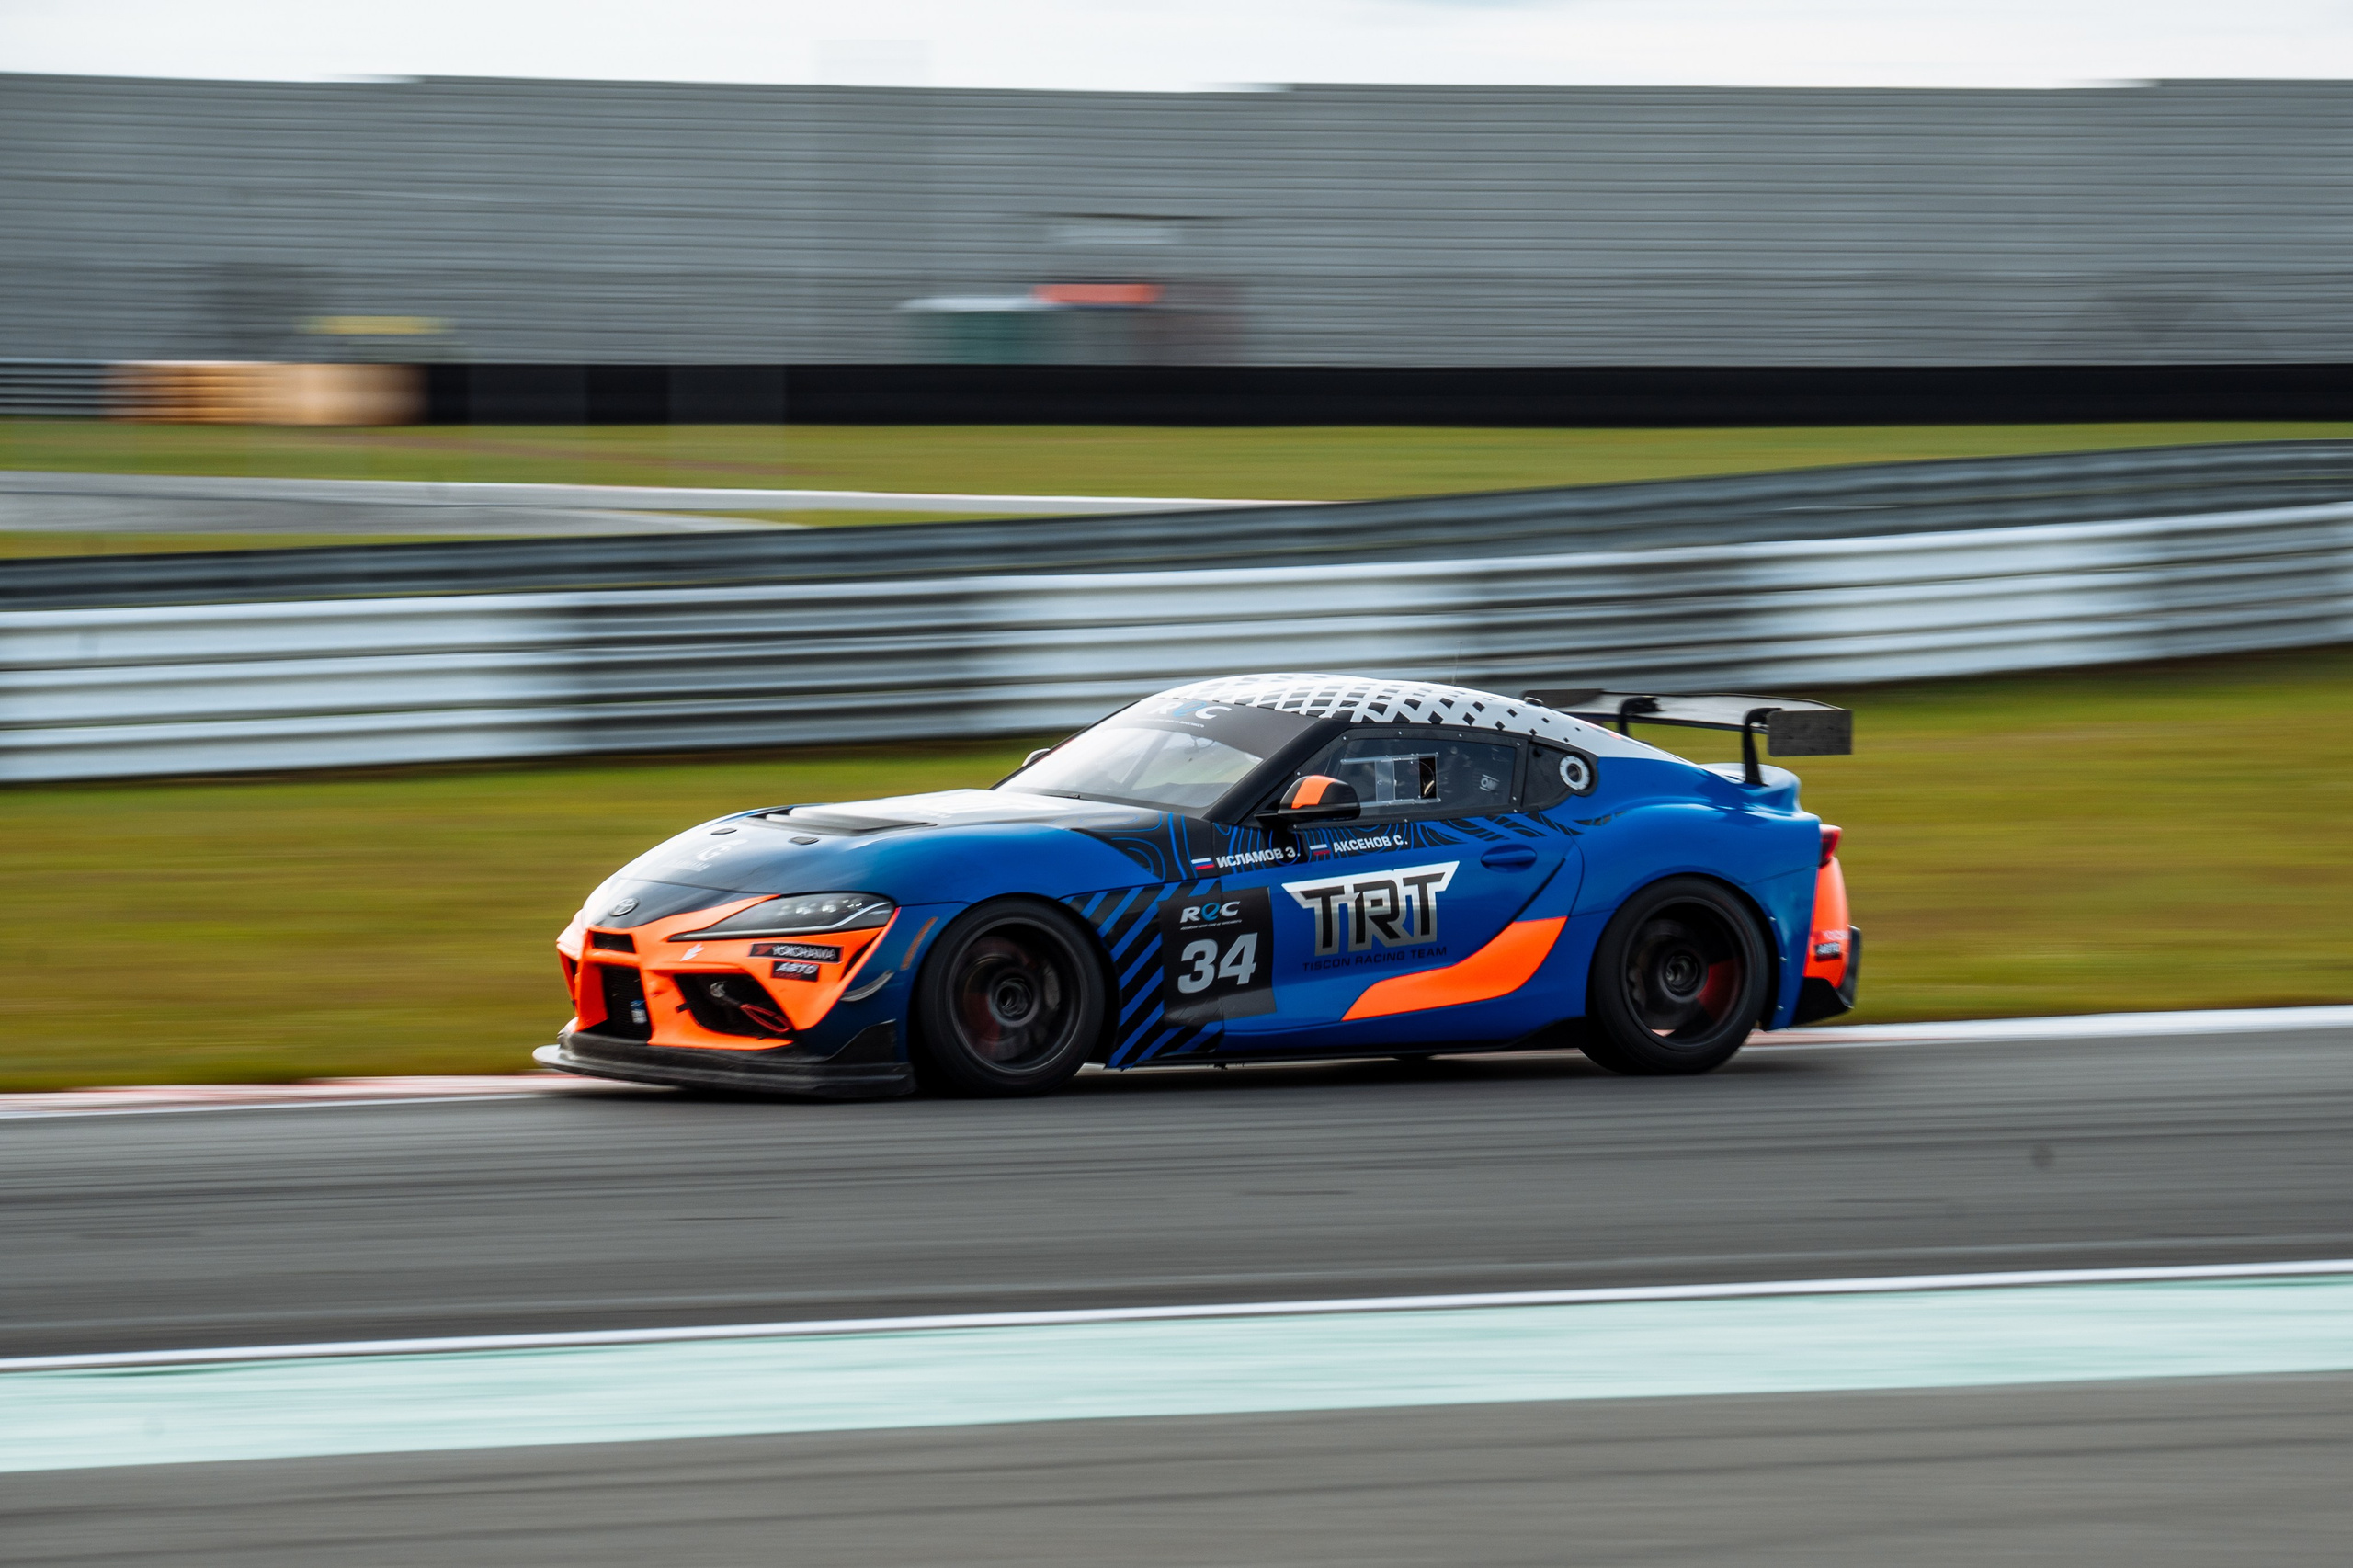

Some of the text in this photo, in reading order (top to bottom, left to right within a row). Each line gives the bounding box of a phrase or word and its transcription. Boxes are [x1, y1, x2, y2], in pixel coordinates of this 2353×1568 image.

[1333, 834, 1408, 853] АКСЕНОВ С.
[1215, 846, 1301, 868] ИСЛАМОВ Э.
[1281, 860, 1460, 956] TRT
[772, 944, 837, 960] YOKOHAMA
[1177, 932, 1258, 994] 34
[1303, 946, 1448, 971] TISCON RACING TEAM
